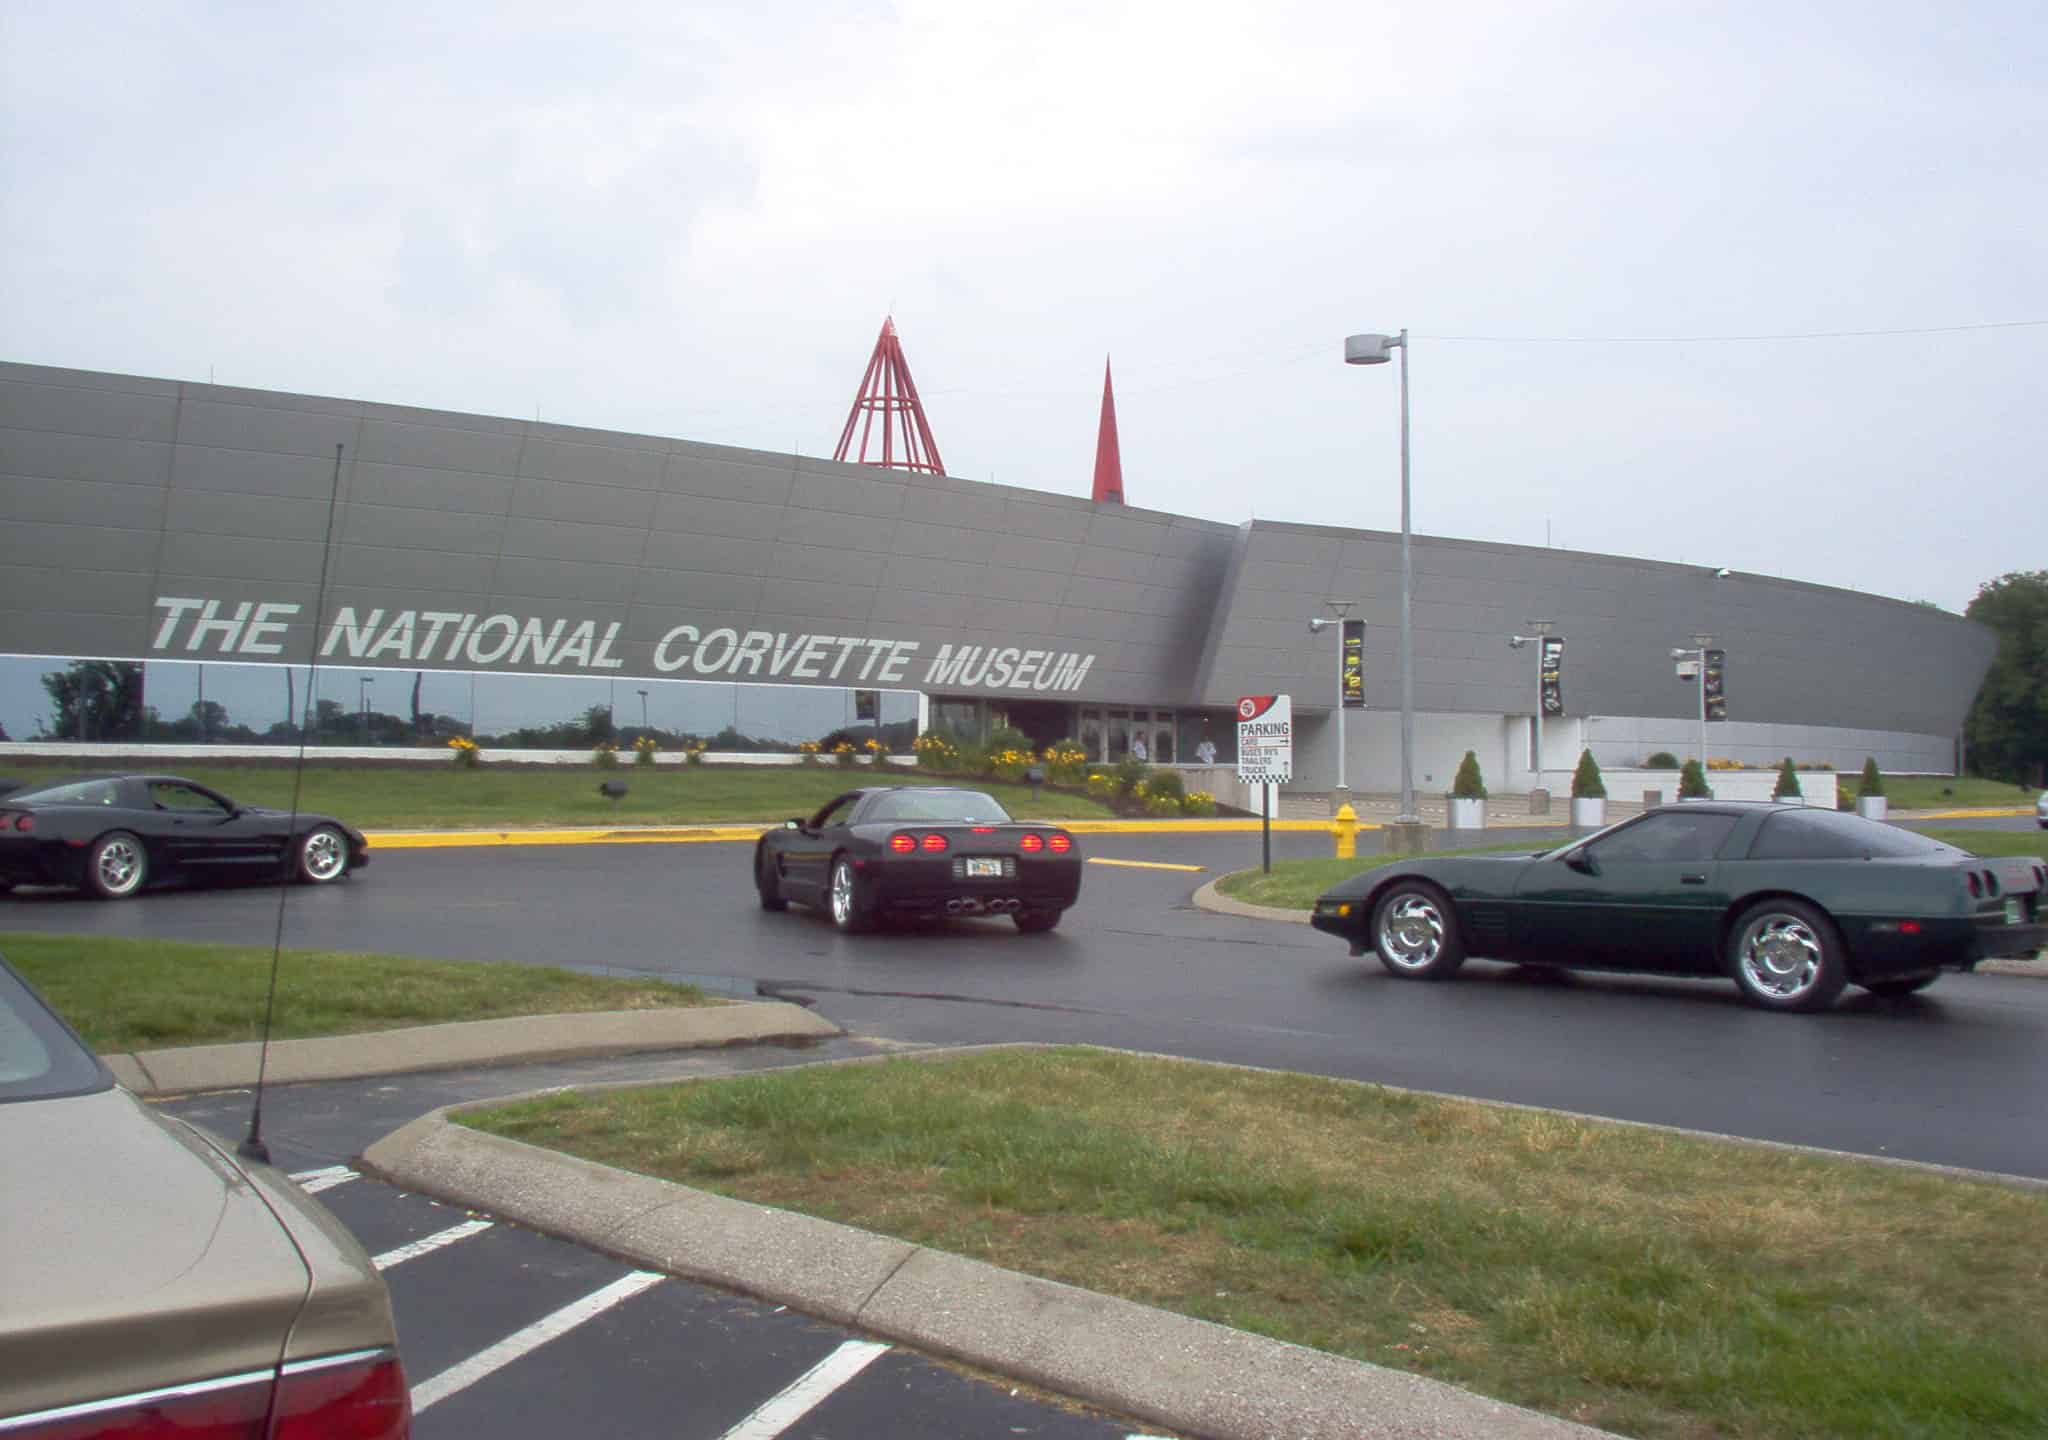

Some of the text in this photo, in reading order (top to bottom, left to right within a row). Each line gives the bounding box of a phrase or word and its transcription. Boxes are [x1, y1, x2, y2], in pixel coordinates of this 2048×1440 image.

[153, 597, 1096, 692] THE NATIONAL CORVETTE MUSEUM
[1240, 722, 1289, 735] PARKING
